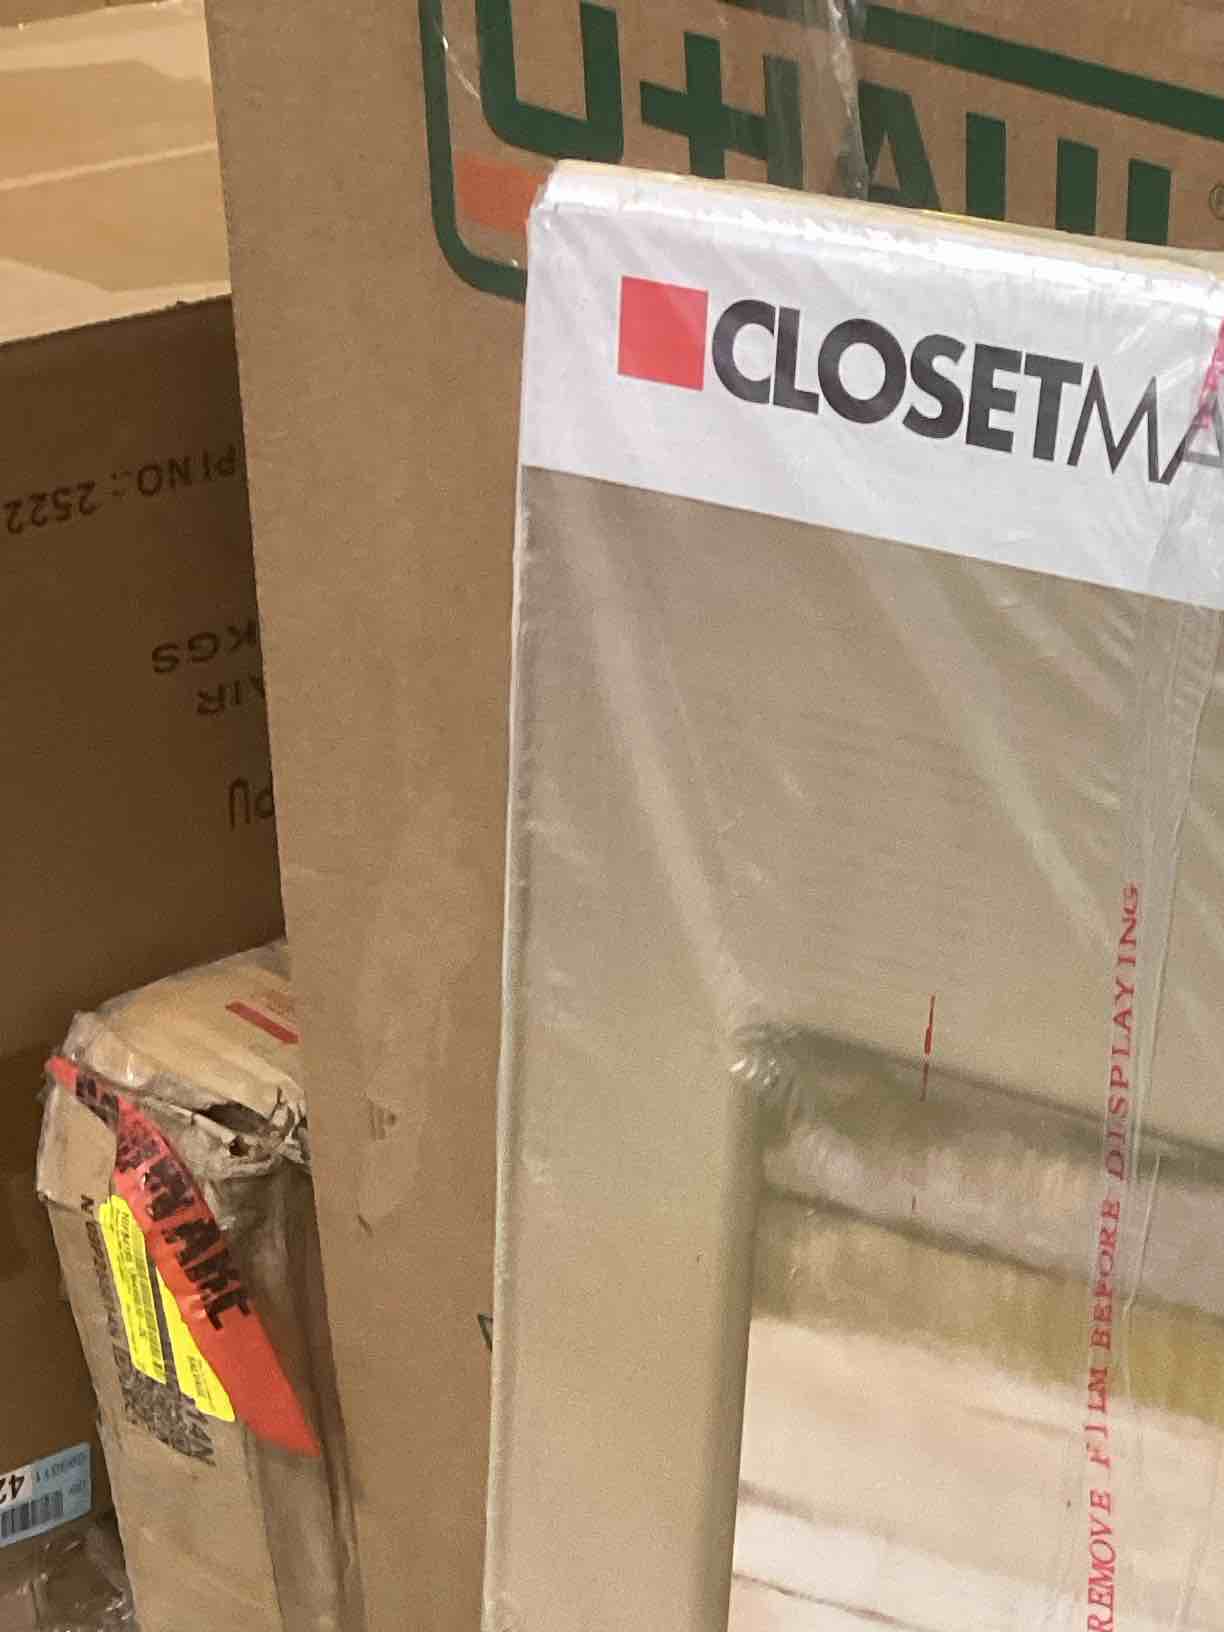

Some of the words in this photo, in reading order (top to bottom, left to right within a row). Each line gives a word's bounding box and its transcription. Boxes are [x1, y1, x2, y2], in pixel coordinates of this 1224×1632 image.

[1106, 881, 1141, 1180] DISPLAYING
[1090, 1199, 1120, 1350] BEFORE
[1084, 1365, 1111, 1469] FILM
